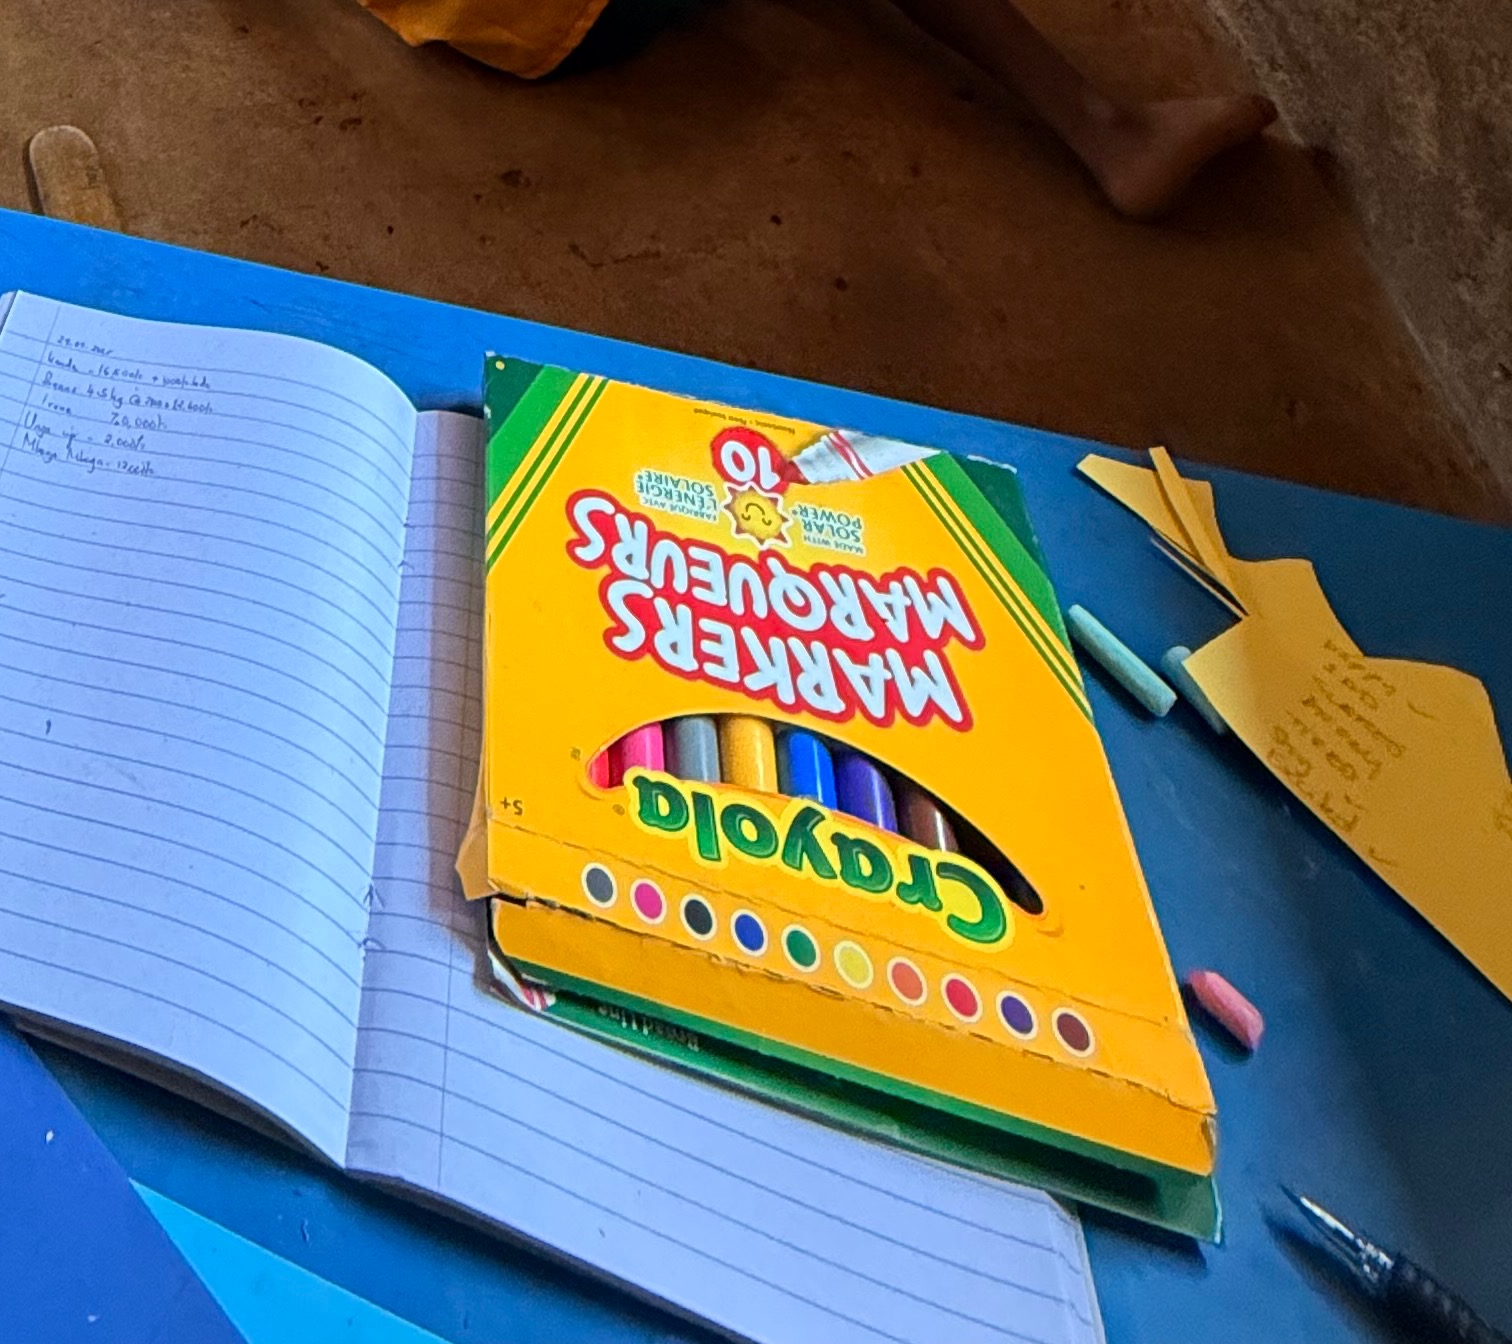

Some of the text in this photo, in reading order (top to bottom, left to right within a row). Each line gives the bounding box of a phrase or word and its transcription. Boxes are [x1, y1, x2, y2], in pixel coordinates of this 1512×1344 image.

[720, 439, 781, 490] 10
[801, 518, 861, 543] SOLAR
[803, 534, 864, 555] MADE WITH
[574, 496, 977, 644] MARQUEURS
[606, 579, 964, 723] MARKERS
[500, 797, 523, 816] 5+
[631, 774, 1008, 945] Crayola
